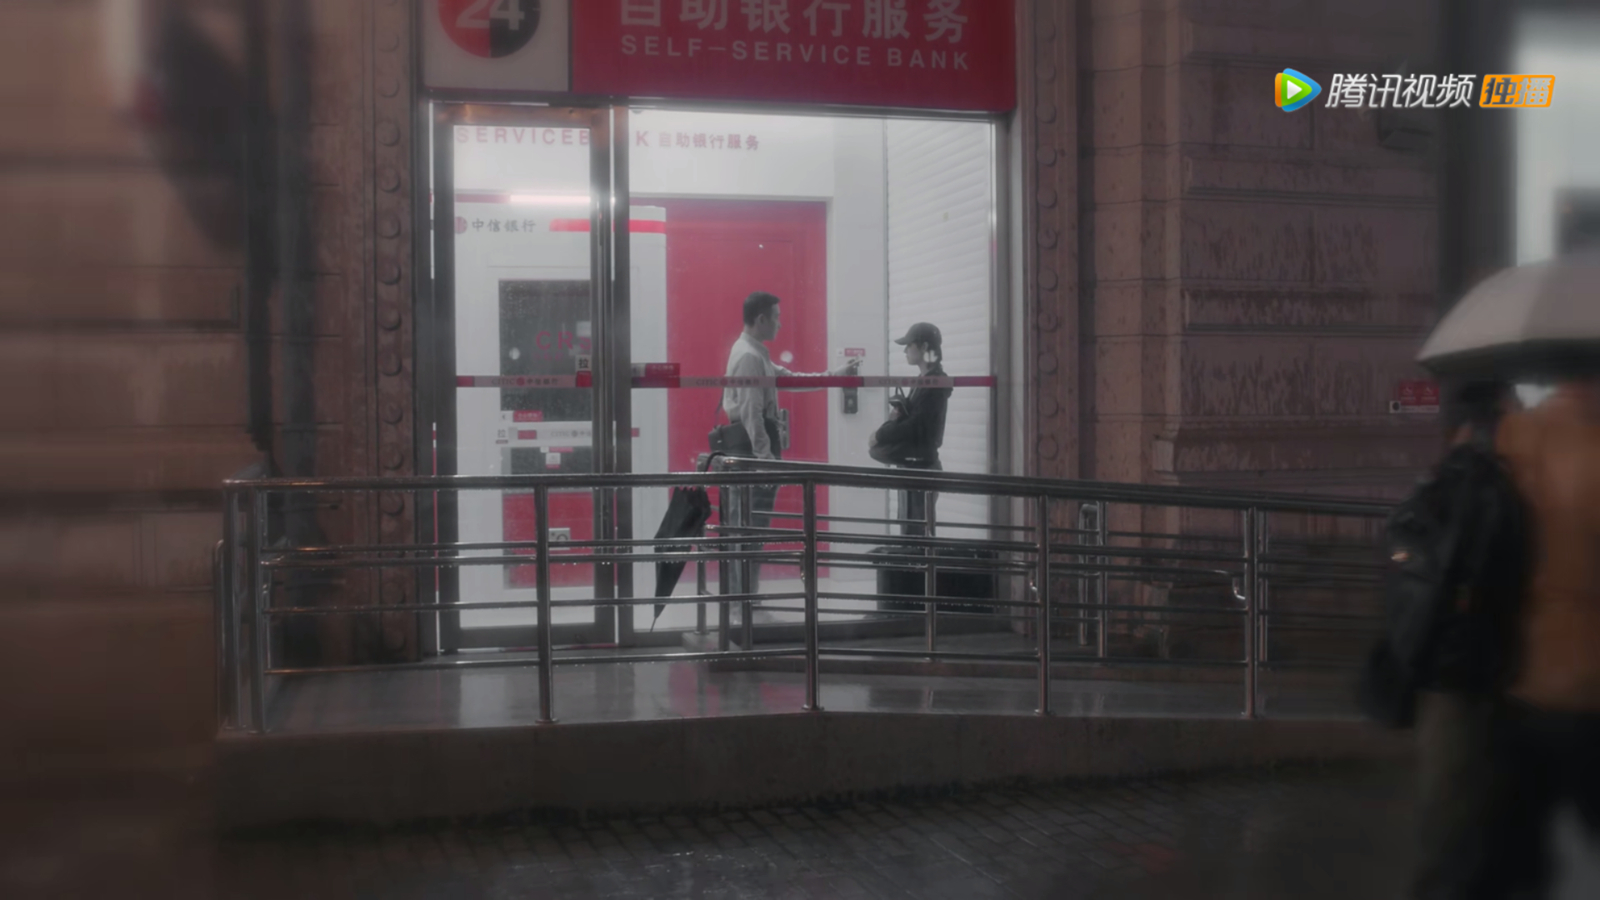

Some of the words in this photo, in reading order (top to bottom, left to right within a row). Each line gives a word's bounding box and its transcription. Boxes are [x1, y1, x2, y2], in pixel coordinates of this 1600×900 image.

[455, 0, 526, 31] 24
[620, 0, 969, 44] 自助银行服务
[620, 35, 871, 67] SELF-SERVICE
[887, 47, 970, 70] BANK
[658, 132, 760, 151] 自助银行服务
[471, 217, 537, 233] 中信银行
[578, 358, 590, 369] 拉
